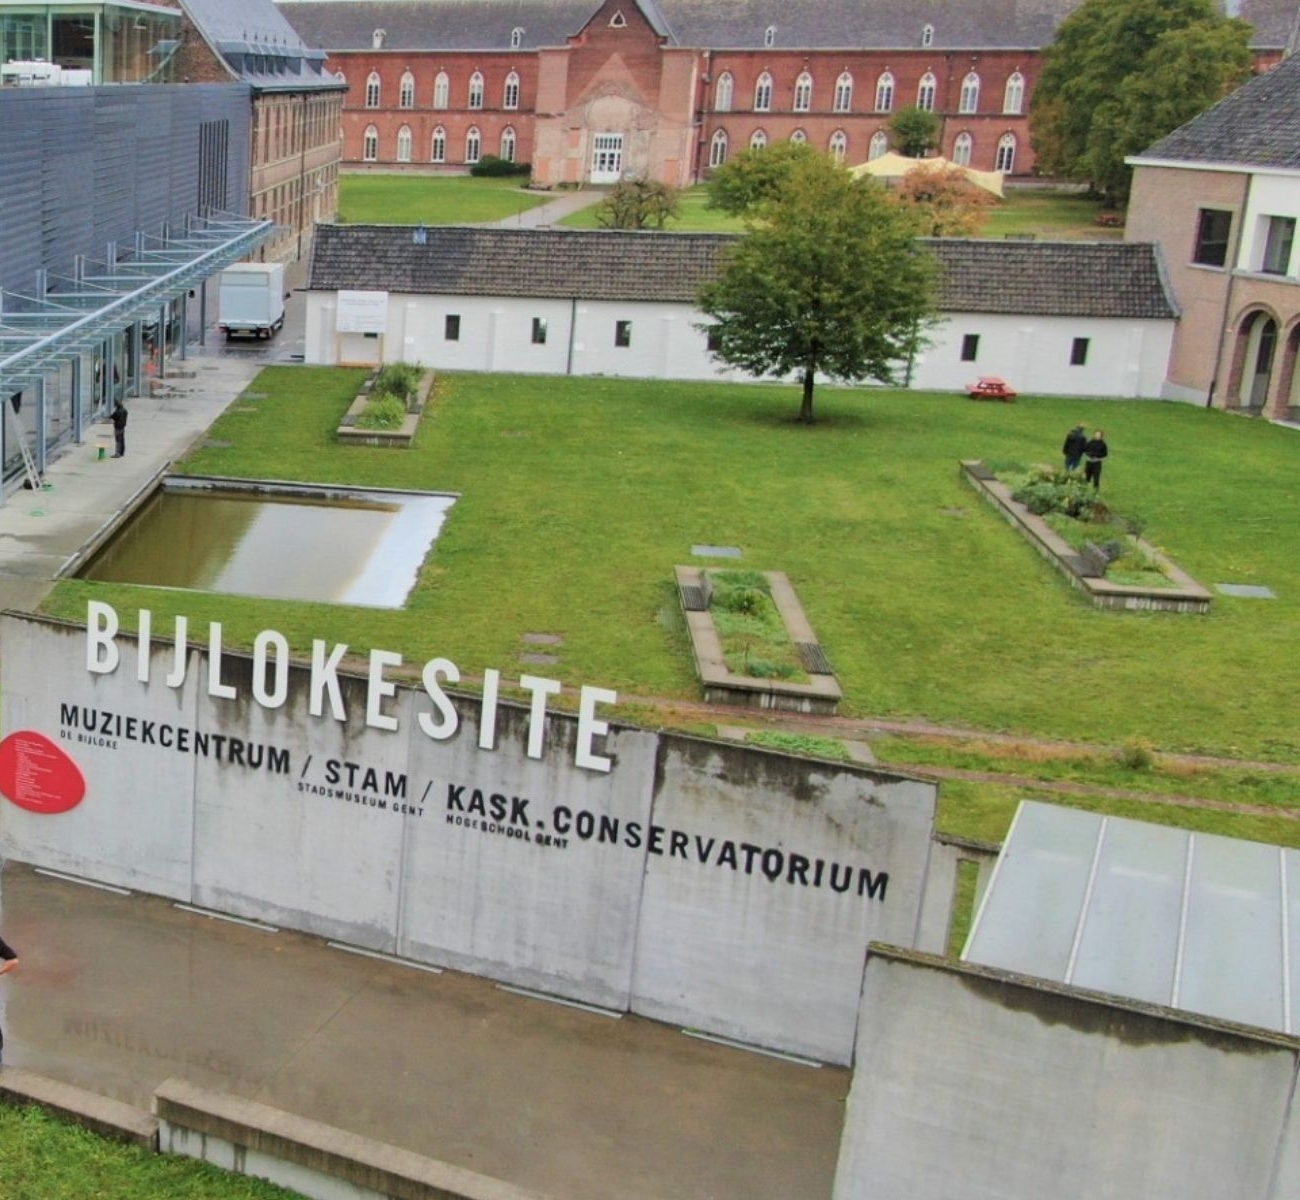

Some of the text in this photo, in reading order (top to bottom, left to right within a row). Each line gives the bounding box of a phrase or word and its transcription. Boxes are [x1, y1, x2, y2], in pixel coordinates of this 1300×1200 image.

[86, 600, 617, 773] BIJLOKESITE
[60, 729, 118, 750] DE BIJLOKE
[60, 703, 291, 774] MUZIEKCENTRUM
[325, 759, 408, 798] STAM
[297, 781, 425, 818] STADSMUSEUM GENT
[446, 814, 570, 850] HOGESCHOOL GENT
